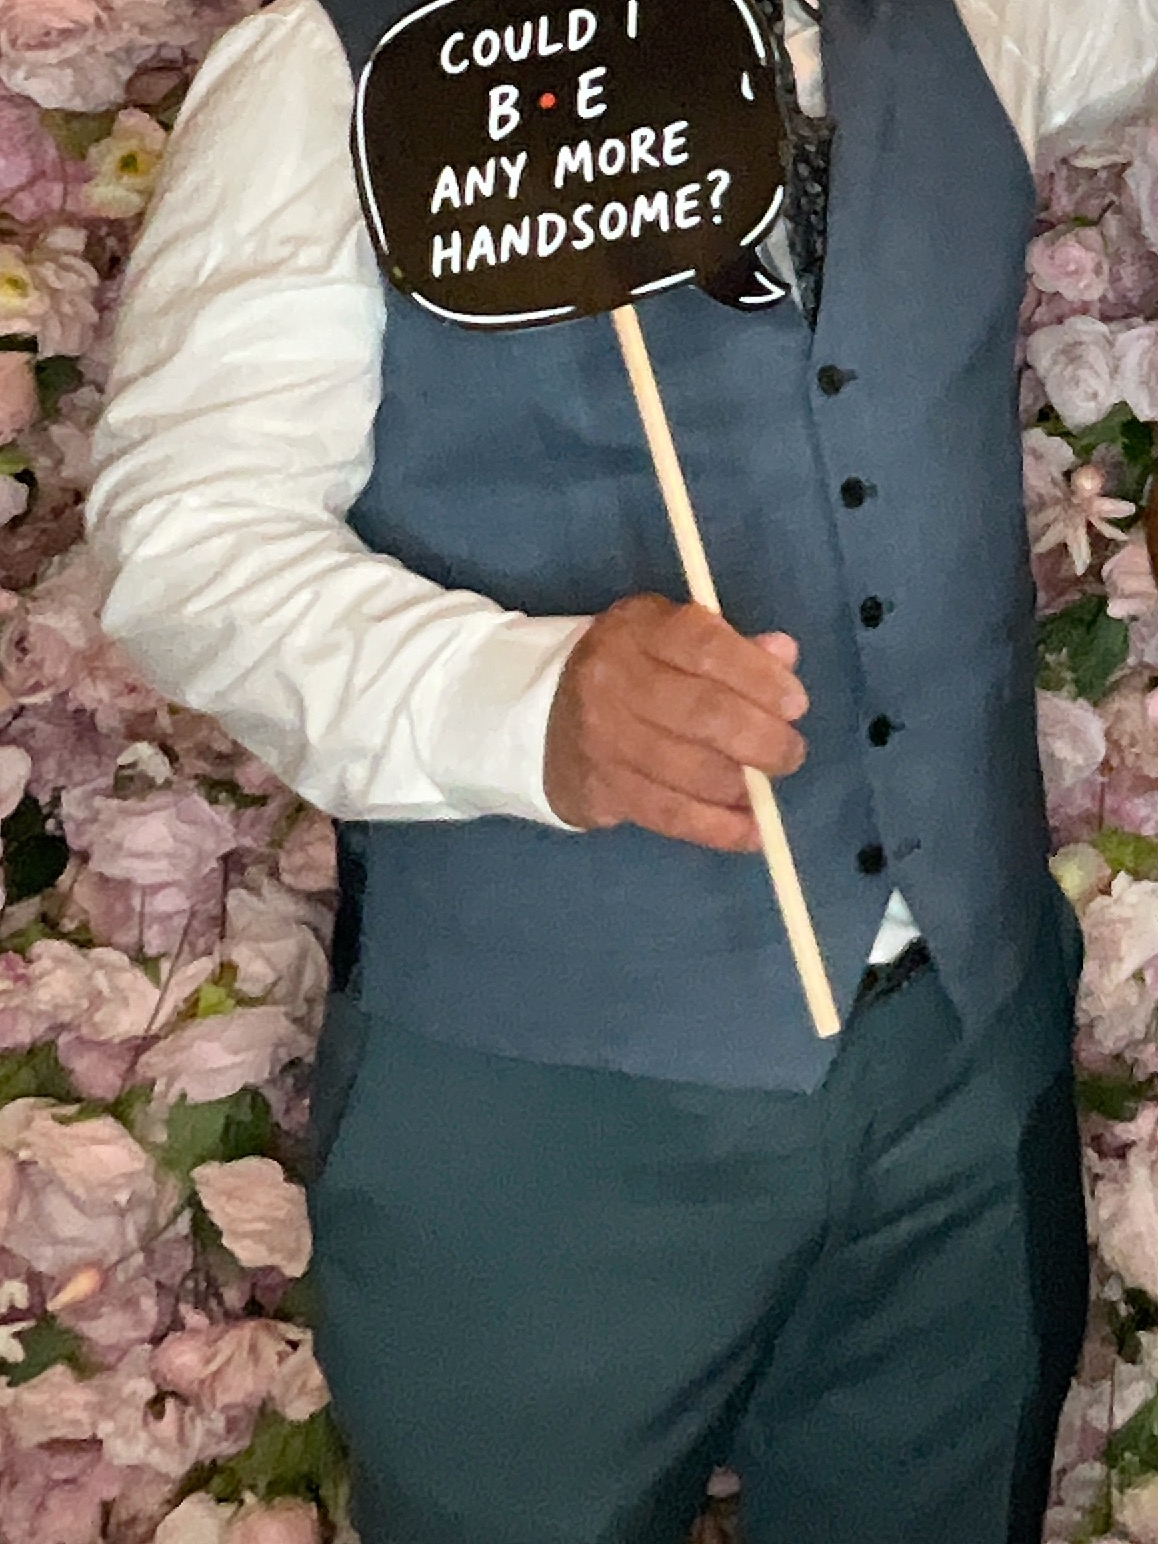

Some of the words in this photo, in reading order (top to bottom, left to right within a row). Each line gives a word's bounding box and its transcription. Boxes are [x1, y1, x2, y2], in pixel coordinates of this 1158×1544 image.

[439, 8, 598, 74] COULD
[430, 151, 528, 214] ANY
[553, 120, 690, 188] MORE
[430, 168, 731, 278] HANDSOME?
